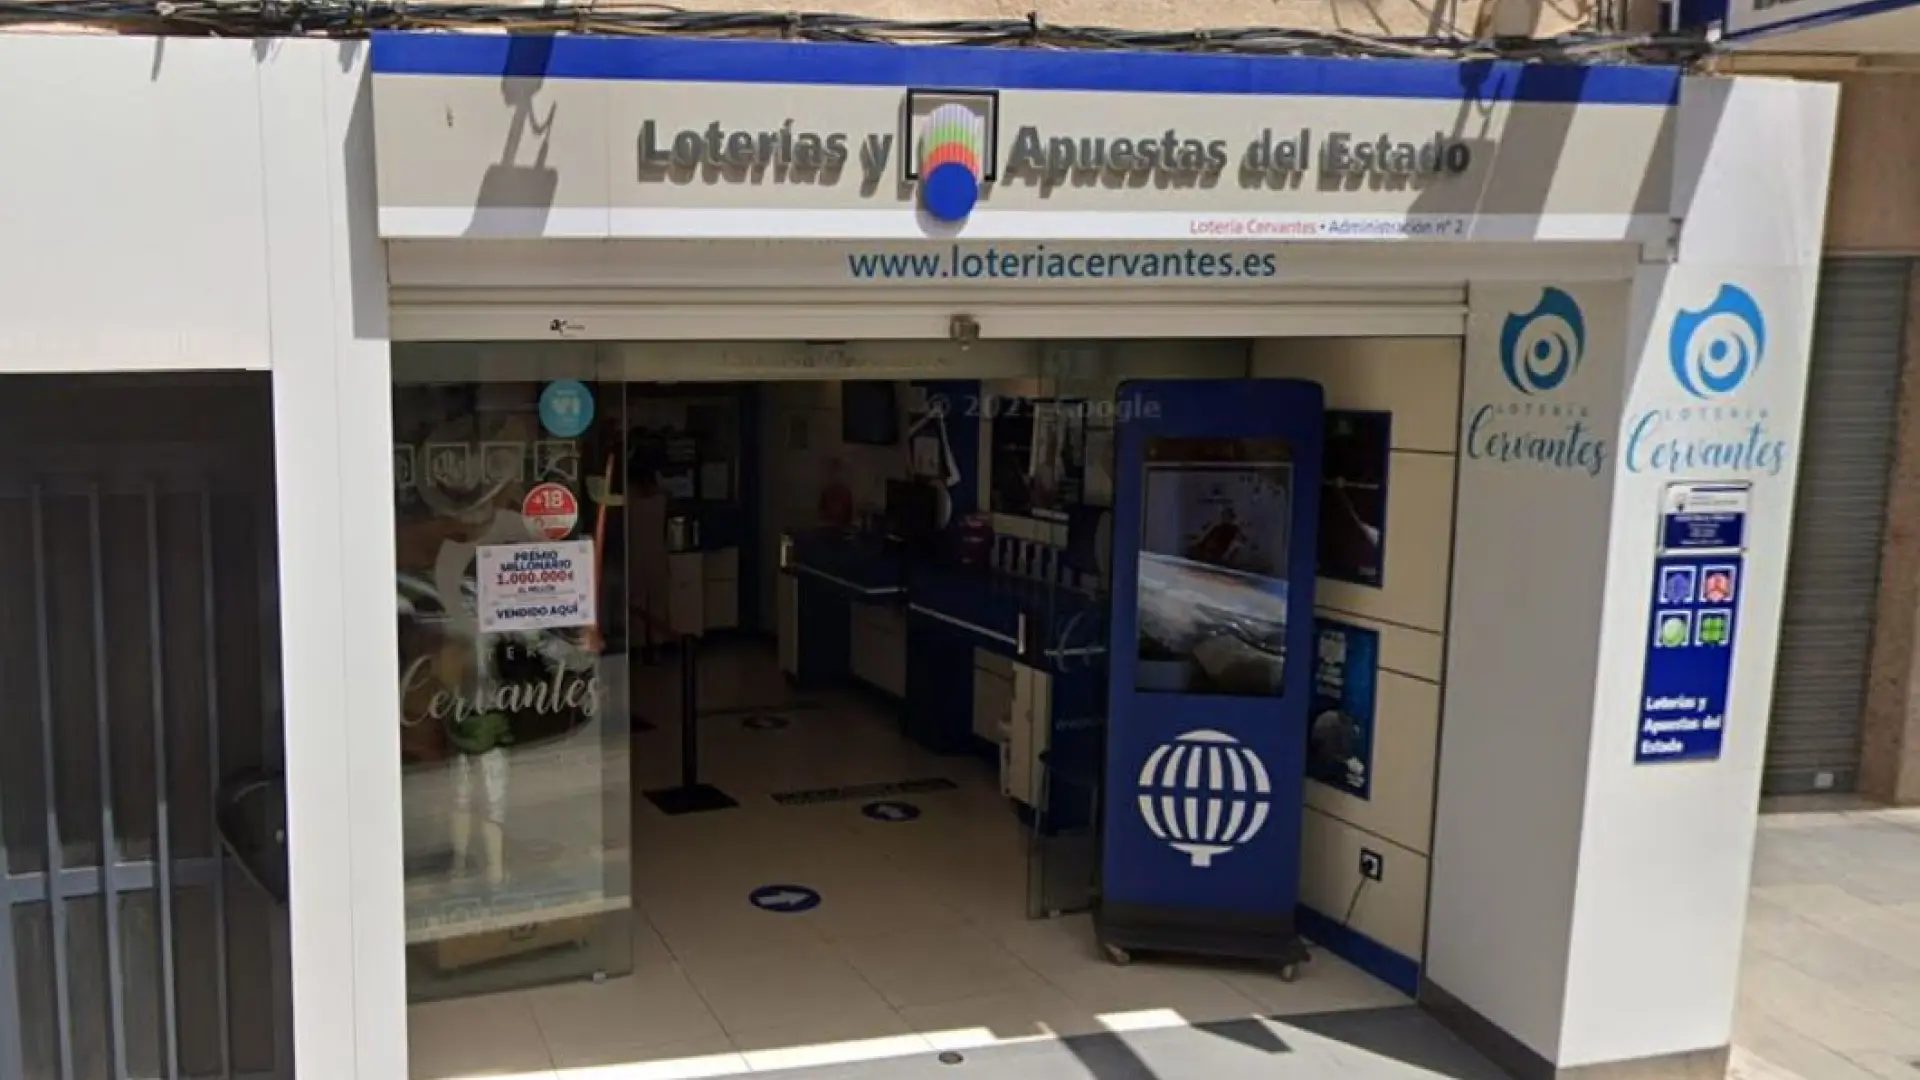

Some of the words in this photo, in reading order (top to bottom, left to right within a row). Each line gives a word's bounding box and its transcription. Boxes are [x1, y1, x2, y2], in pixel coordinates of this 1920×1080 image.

[639, 118, 849, 176] Loterías
[861, 133, 894, 187] y
[1008, 126, 1228, 182] Apuestas
[1247, 128, 1312, 178] del
[1323, 131, 1471, 180] Estado
[848, 245, 1277, 278] www.loteriacervantes.es
[1466, 404, 1606, 475] Cervantes
[1626, 410, 1786, 475] Cervantes
[496, 607, 548, 618] VENDIDO
[400, 656, 602, 727] Cervantes
